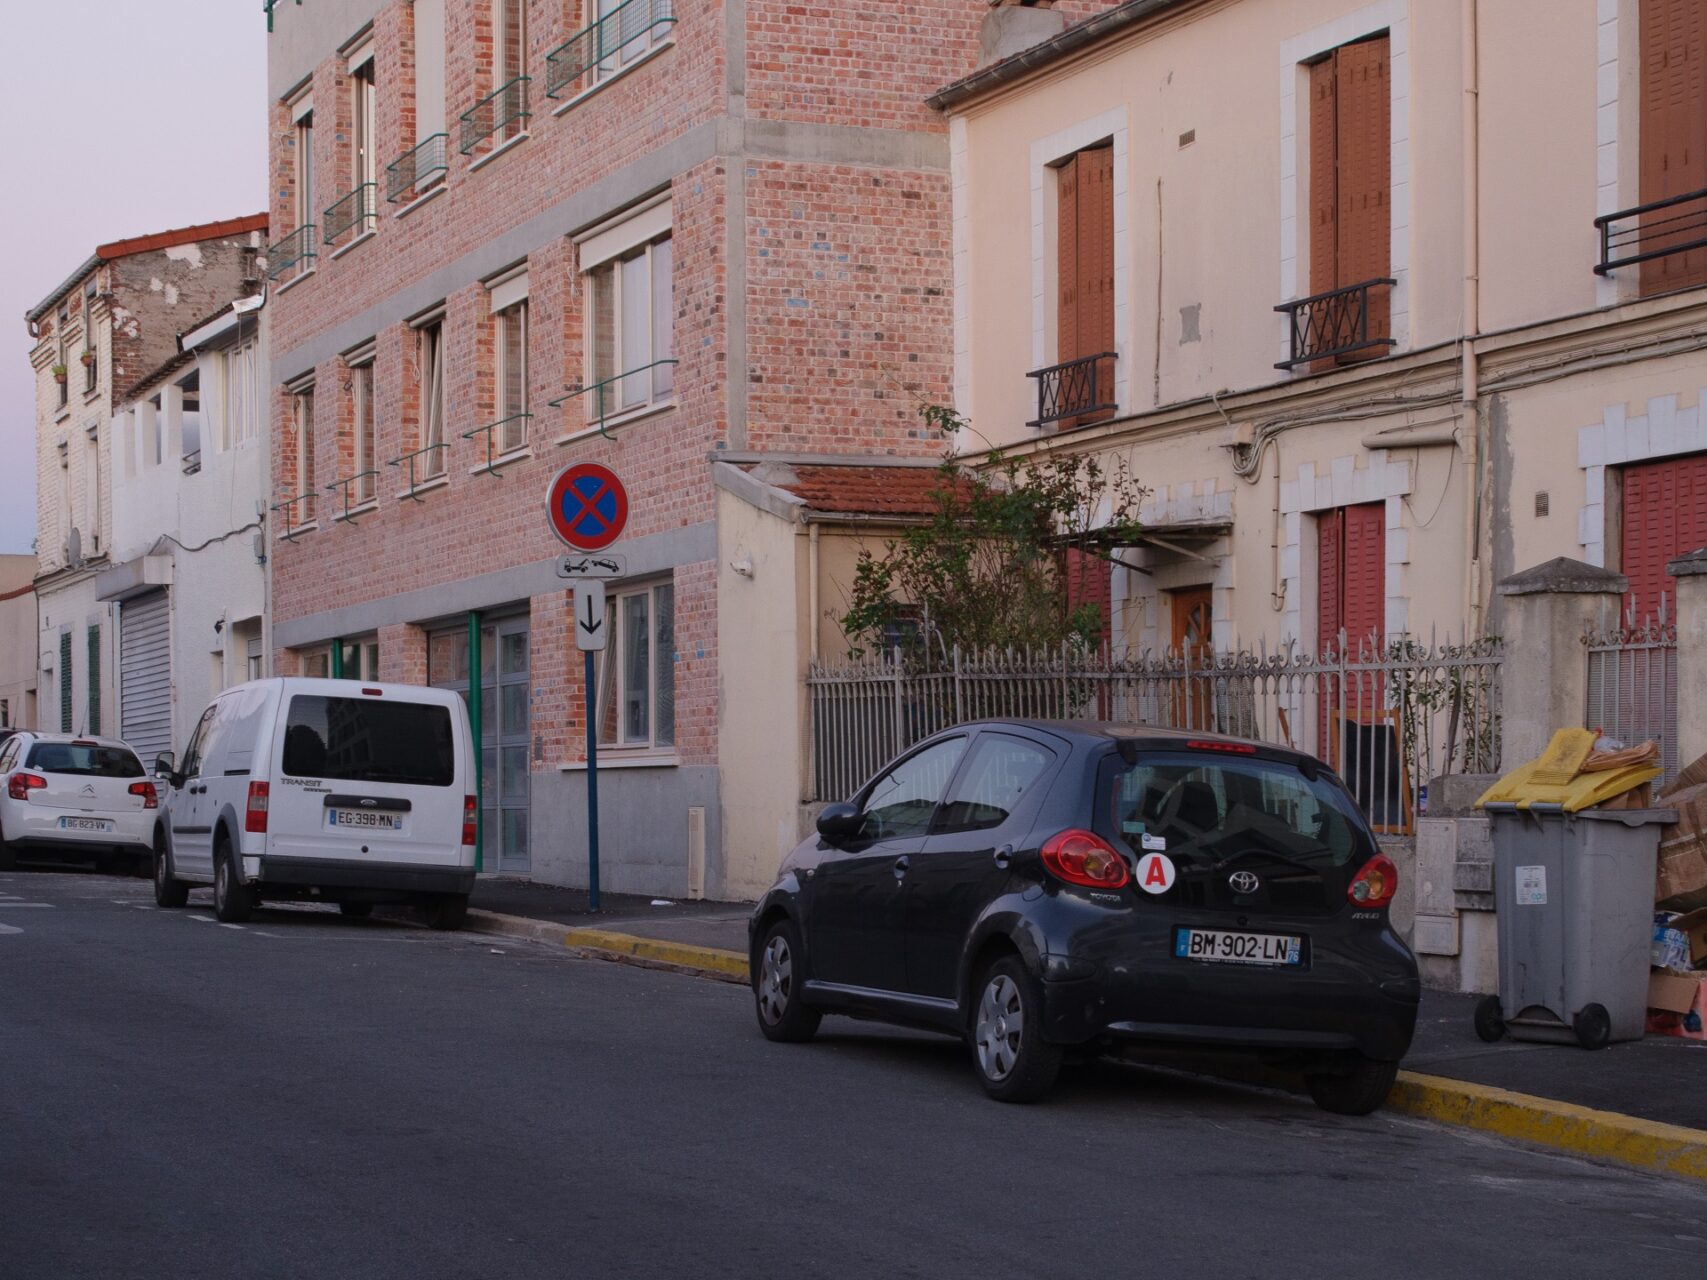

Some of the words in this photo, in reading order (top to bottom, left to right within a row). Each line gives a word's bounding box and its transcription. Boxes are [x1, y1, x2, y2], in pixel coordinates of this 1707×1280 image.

[281, 778, 322, 787] TRANSIT
[338, 811, 393, 827] EG-398-MN
[1145, 857, 1166, 886] A
[1190, 932, 1288, 960] BM-902-LN
